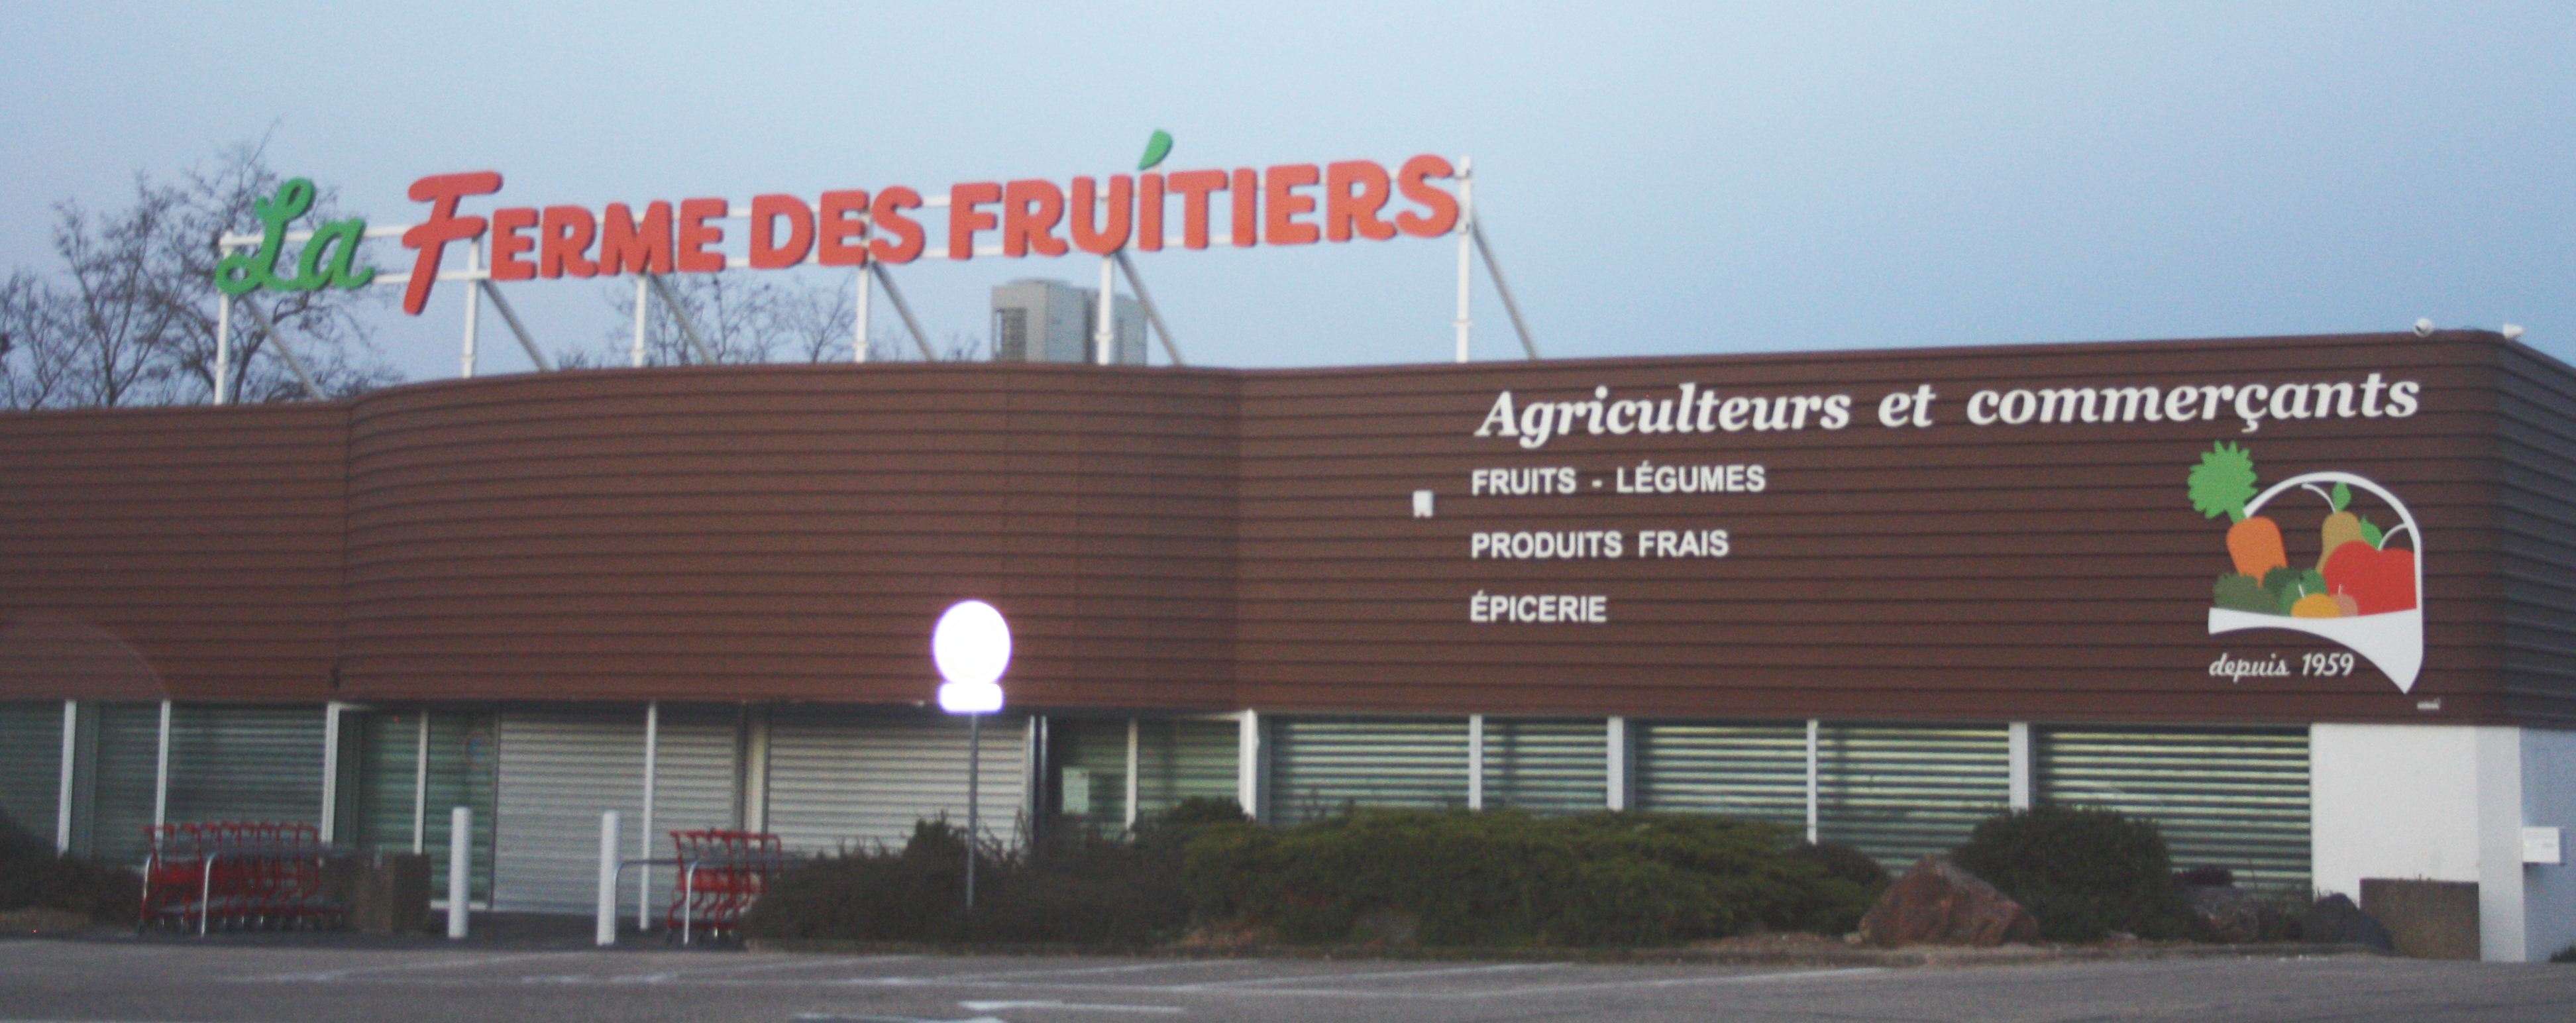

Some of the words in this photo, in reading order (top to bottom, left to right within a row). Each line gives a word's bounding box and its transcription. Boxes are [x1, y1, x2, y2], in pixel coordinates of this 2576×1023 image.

[215, 178, 374, 294] La
[402, 171, 727, 314] FERME
[749, 186, 925, 269] DES
[1474, 382, 1852, 450] Agriculteurs
[1878, 384, 1937, 428] et
[1966, 372, 2420, 433] commerçants
[1471, 466, 1578, 496] FRUITS
[1616, 459, 1766, 494] LÉGUMES
[1471, 530, 1623, 559] PRODUITS
[1638, 529, 1730, 557] FRAIS
[1470, 589, 1607, 623] ÉPICERIE
[2208, 653, 2290, 683] depuis
[2302, 653, 2355, 677] 1959
